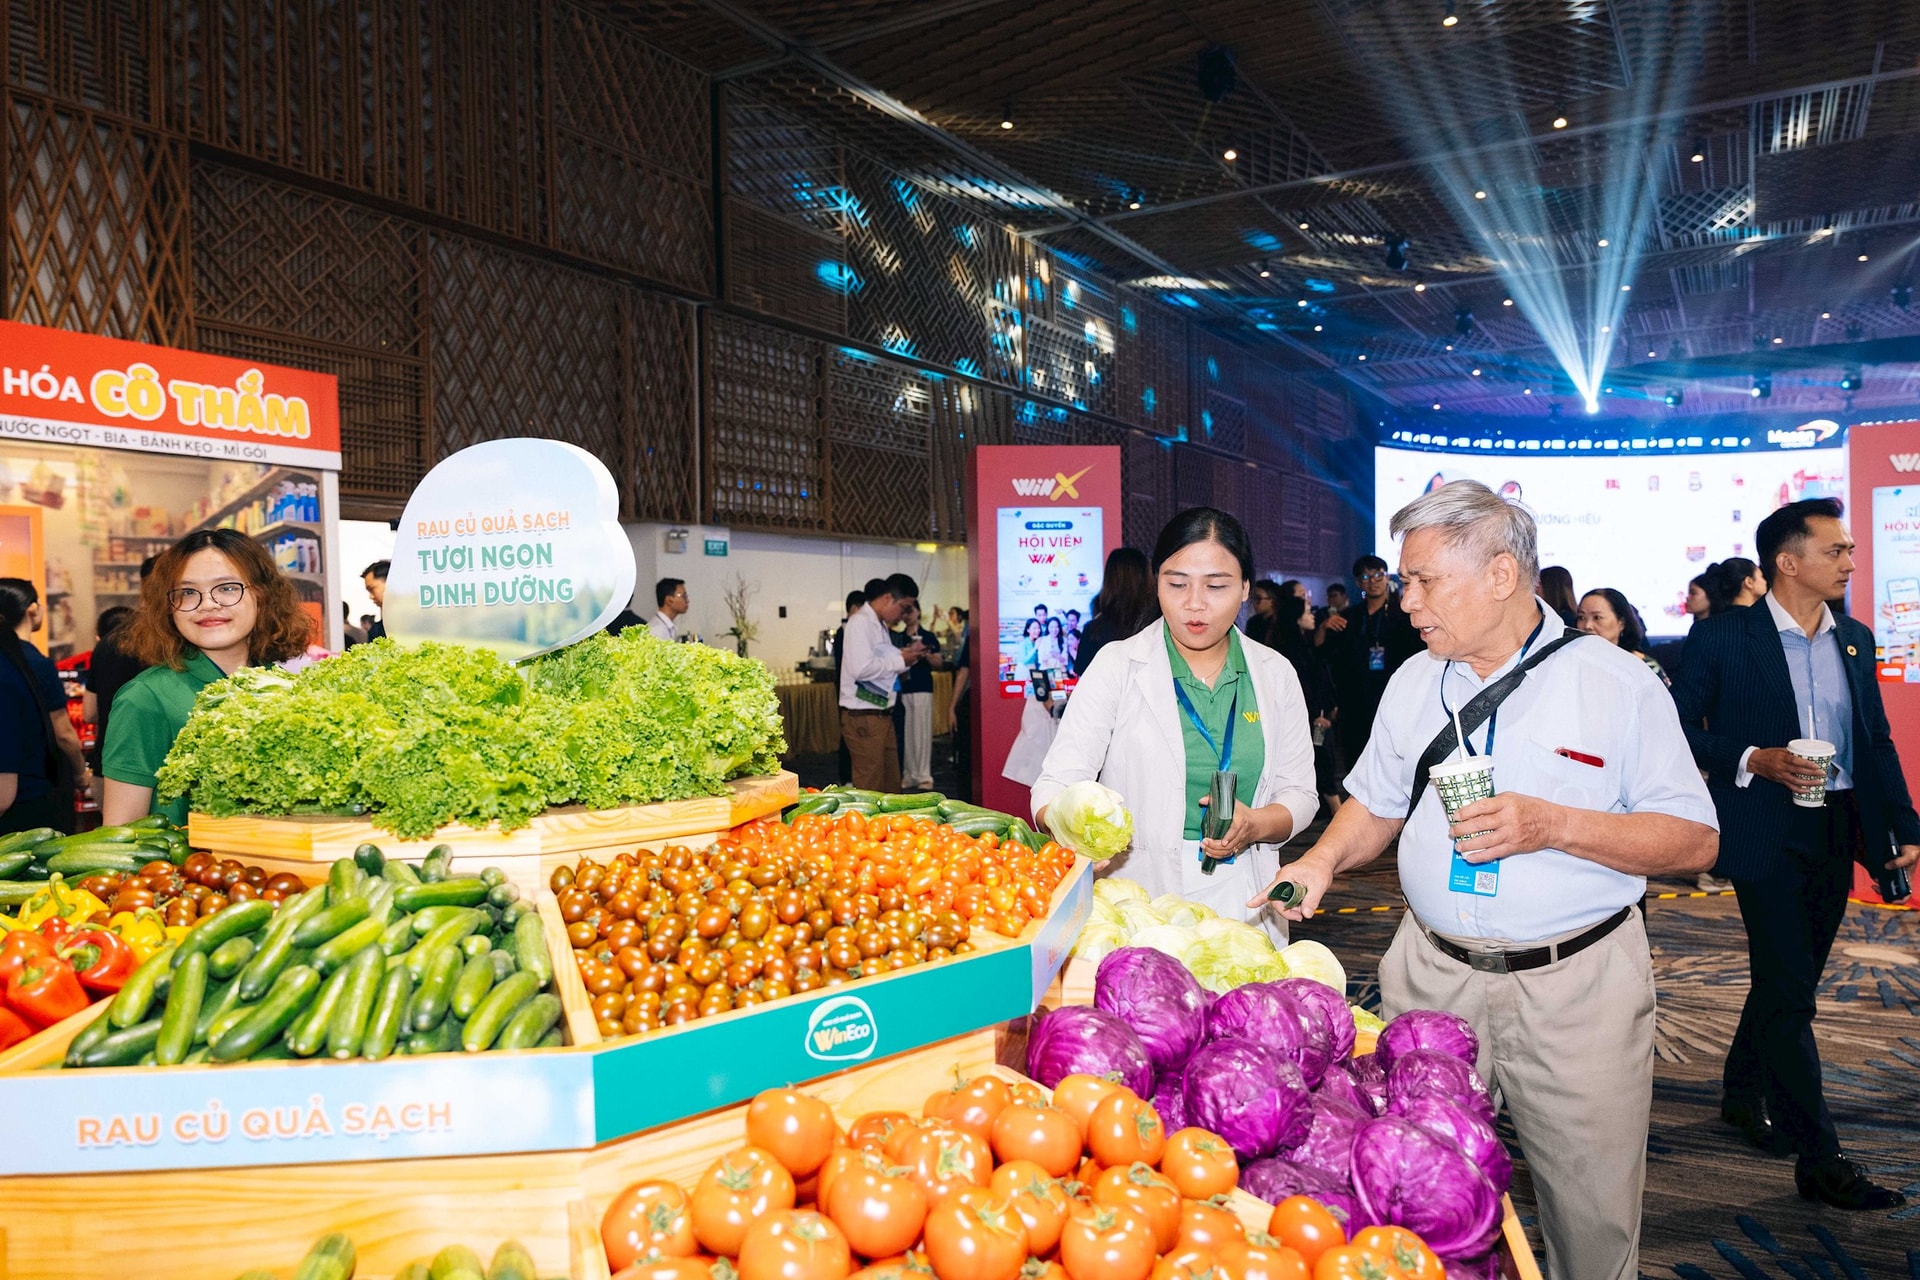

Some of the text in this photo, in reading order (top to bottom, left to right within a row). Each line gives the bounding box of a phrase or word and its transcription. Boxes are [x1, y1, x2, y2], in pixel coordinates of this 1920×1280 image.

[3, 364, 310, 438] HÓA CÔ THẮM
[45, 426, 91, 443] NGỌT
[104, 431, 128, 443] BIA
[417, 509, 570, 538] RAU CỦ QUẢ SẠCH
[417, 542, 553, 573] TƯƠI NGON
[1019, 534, 1082, 551] HỘI VIÊN
[420, 574, 575, 608] DINH DƯỠNG
[77, 1095, 452, 1146] RAU CỦ QUẢ SẠCH
